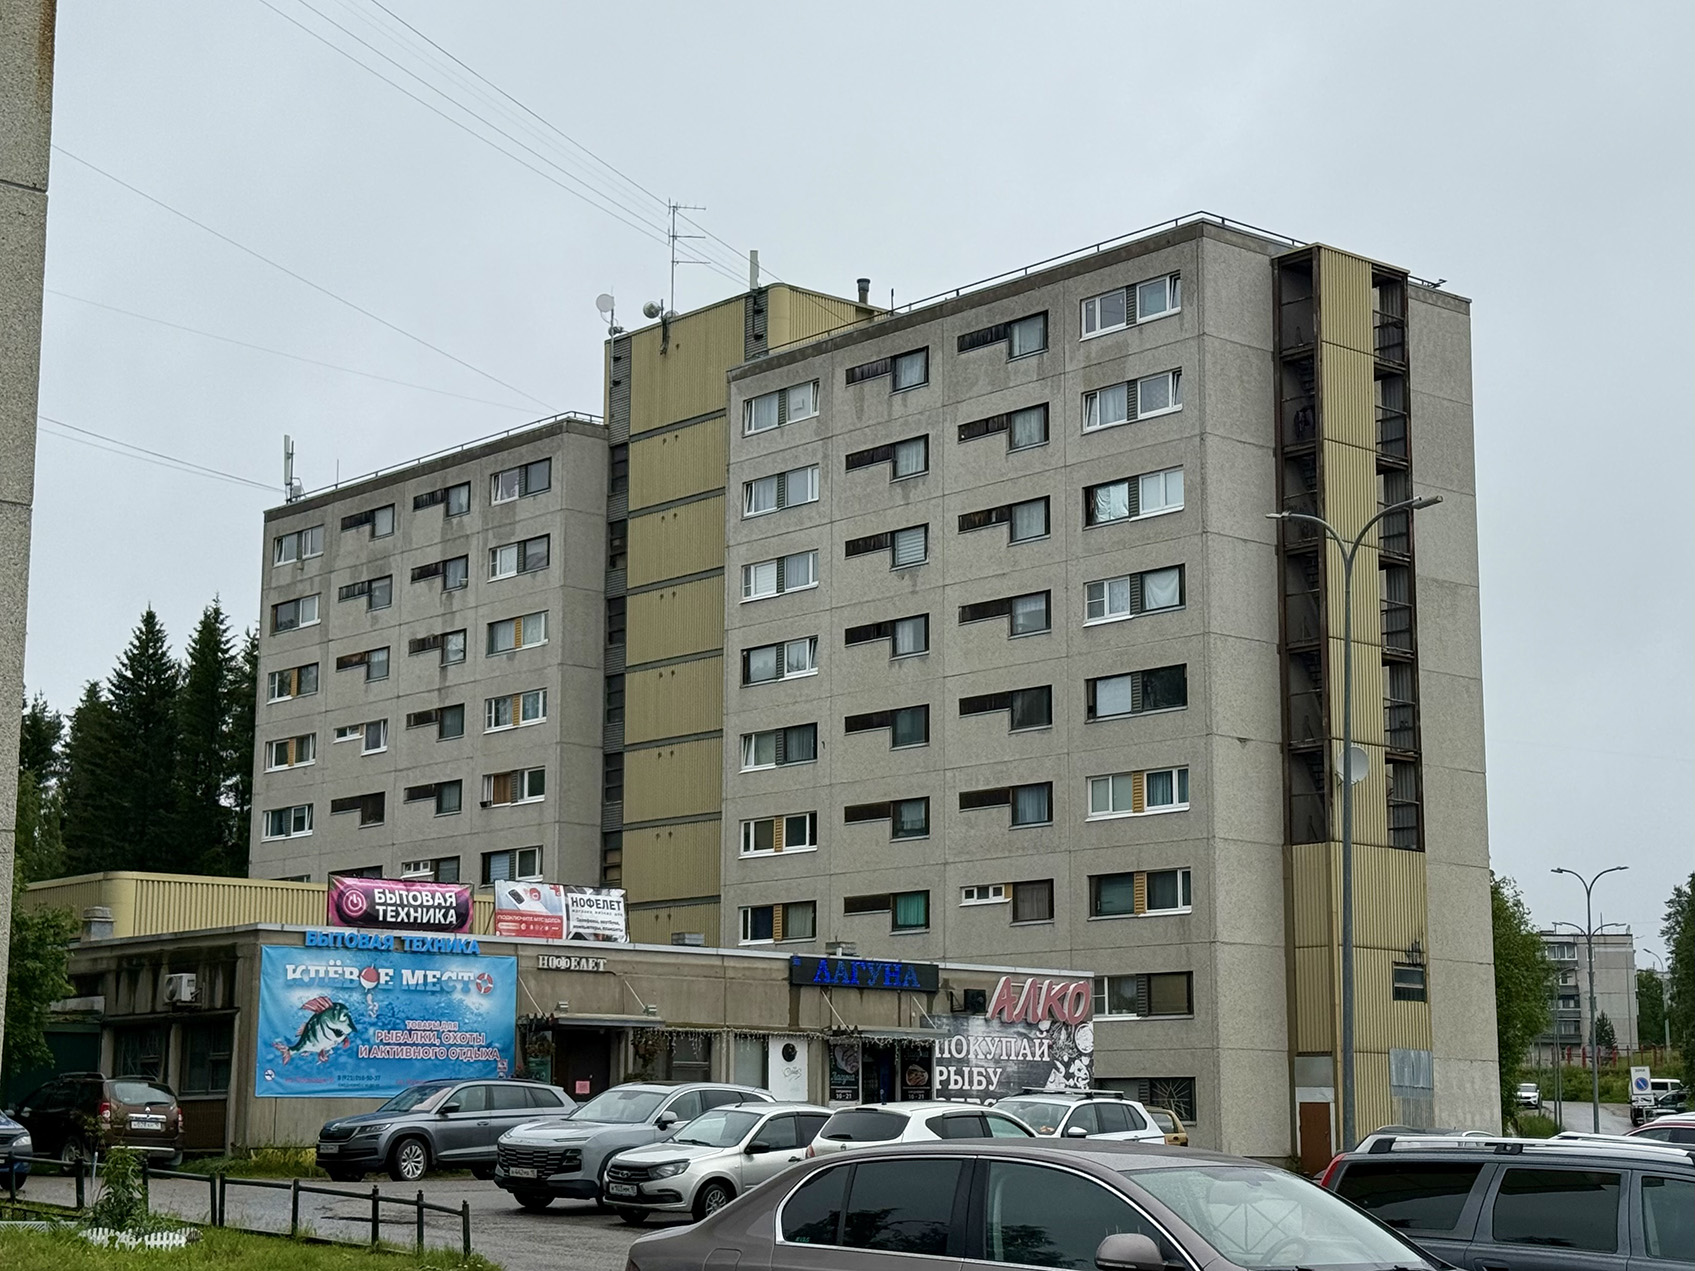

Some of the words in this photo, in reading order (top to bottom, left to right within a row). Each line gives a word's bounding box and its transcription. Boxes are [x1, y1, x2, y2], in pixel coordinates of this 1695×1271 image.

[374, 888, 456, 907] БЫТОВАЯ
[571, 896, 622, 911] НОФЕЛЕТ
[375, 905, 457, 924] ТЕХНИКА
[305, 930, 395, 950] БЫТОВАЯ
[401, 935, 481, 955] ТЕХНИКА
[538, 955, 608, 971] НОФЕЛЕТ
[401, 969, 494, 994] МЕСТО
[813, 959, 921, 988] ЛАГУНА
[985, 975, 1091, 1025] АЛКО
[405, 1020, 440, 1031] ТОВАРЫ
[440, 1021, 459, 1032] ДЛЯ
[376, 1030, 441, 1046] РЫБАЛКИ,
[441, 1031, 486, 1045] ОХОТЫ
[936, 1031, 1051, 1062] ПОКУПАЙ
[358, 1045, 369, 1059] И
[369, 1045, 447, 1060] АКТИВНОГО
[448, 1047, 500, 1062] ОТДЫХА
[936, 1065, 1003, 1091] РЫБУ
